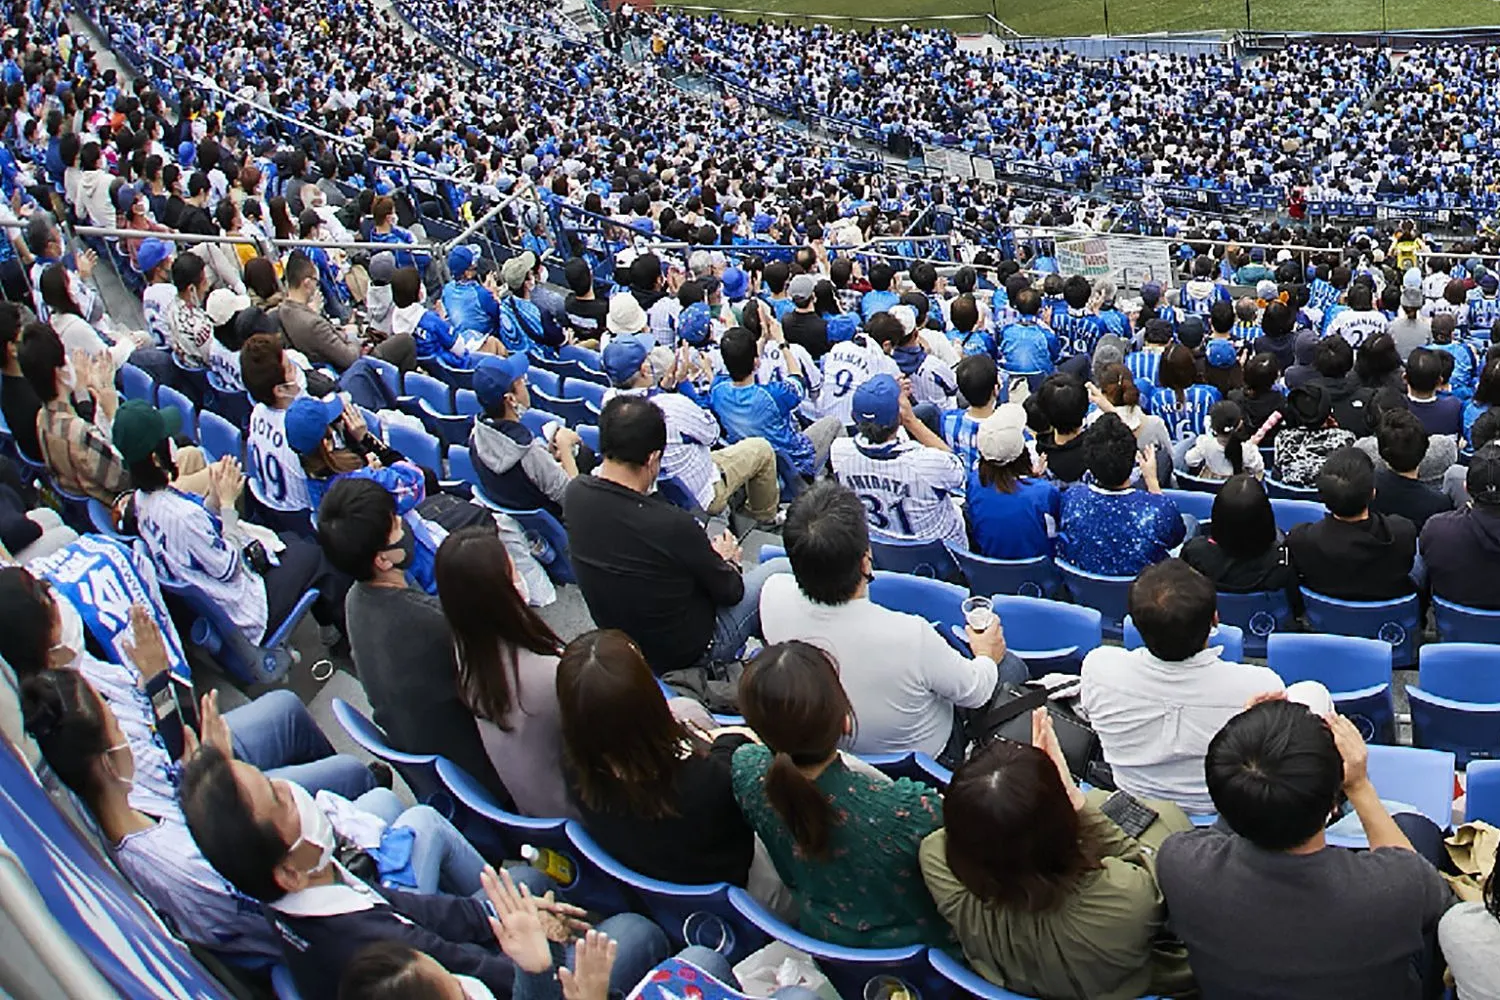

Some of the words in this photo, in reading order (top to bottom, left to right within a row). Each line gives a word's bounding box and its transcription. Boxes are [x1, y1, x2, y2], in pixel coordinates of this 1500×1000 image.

[833, 369, 854, 397] 9
[252, 416, 283, 448] SOTO
[1176, 419, 1197, 442] 6
[858, 493, 916, 536] 31
